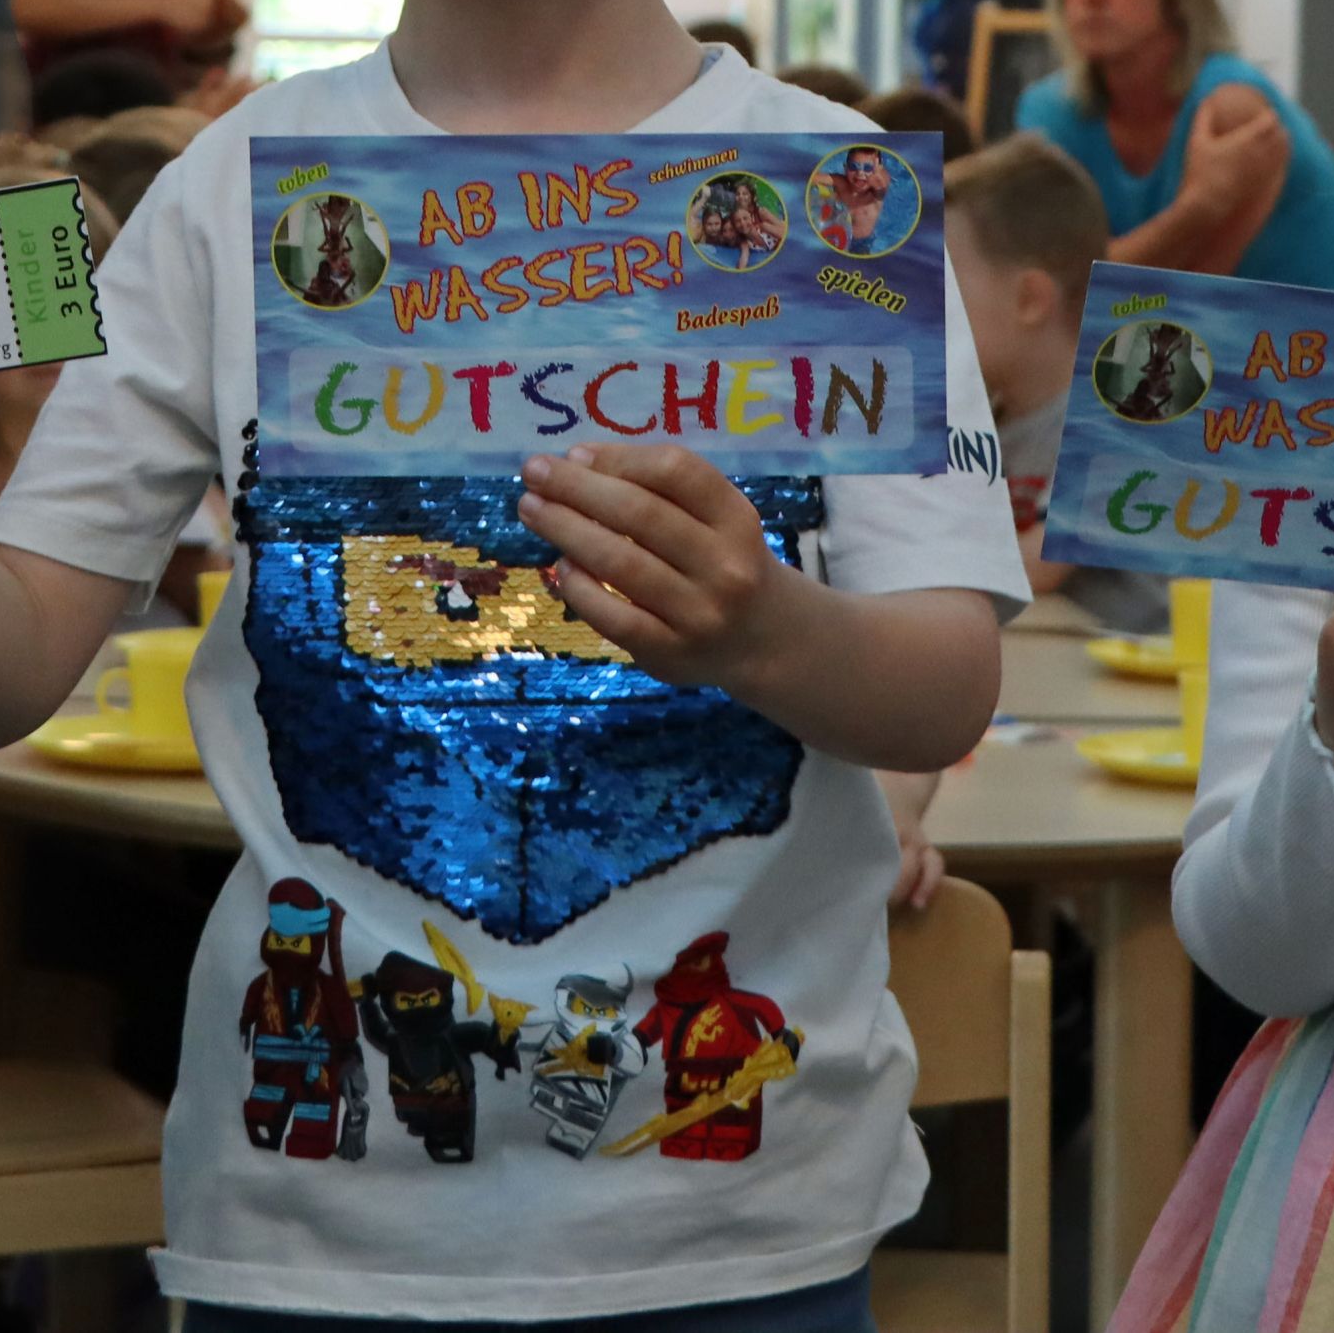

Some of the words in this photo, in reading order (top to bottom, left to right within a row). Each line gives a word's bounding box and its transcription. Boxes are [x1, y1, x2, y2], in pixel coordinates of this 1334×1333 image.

[276, 162, 329, 195] toben
[649, 147, 738, 184] schwimmen
[419, 181, 496, 247] AB
[518, 158, 639, 231] INS
[19, 230, 47, 325] Kinder
[52, 225, 78, 291] Euro
[390, 231, 684, 334] WASSER!
[61, 301, 83, 318] 3
[677, 295, 780, 333] Badespaß
[817, 264, 907, 314] spielen
[1111, 292, 1167, 318] toben
[1243, 329, 1328, 382] AB
[315, 355, 889, 439] GUTSCHEIN
